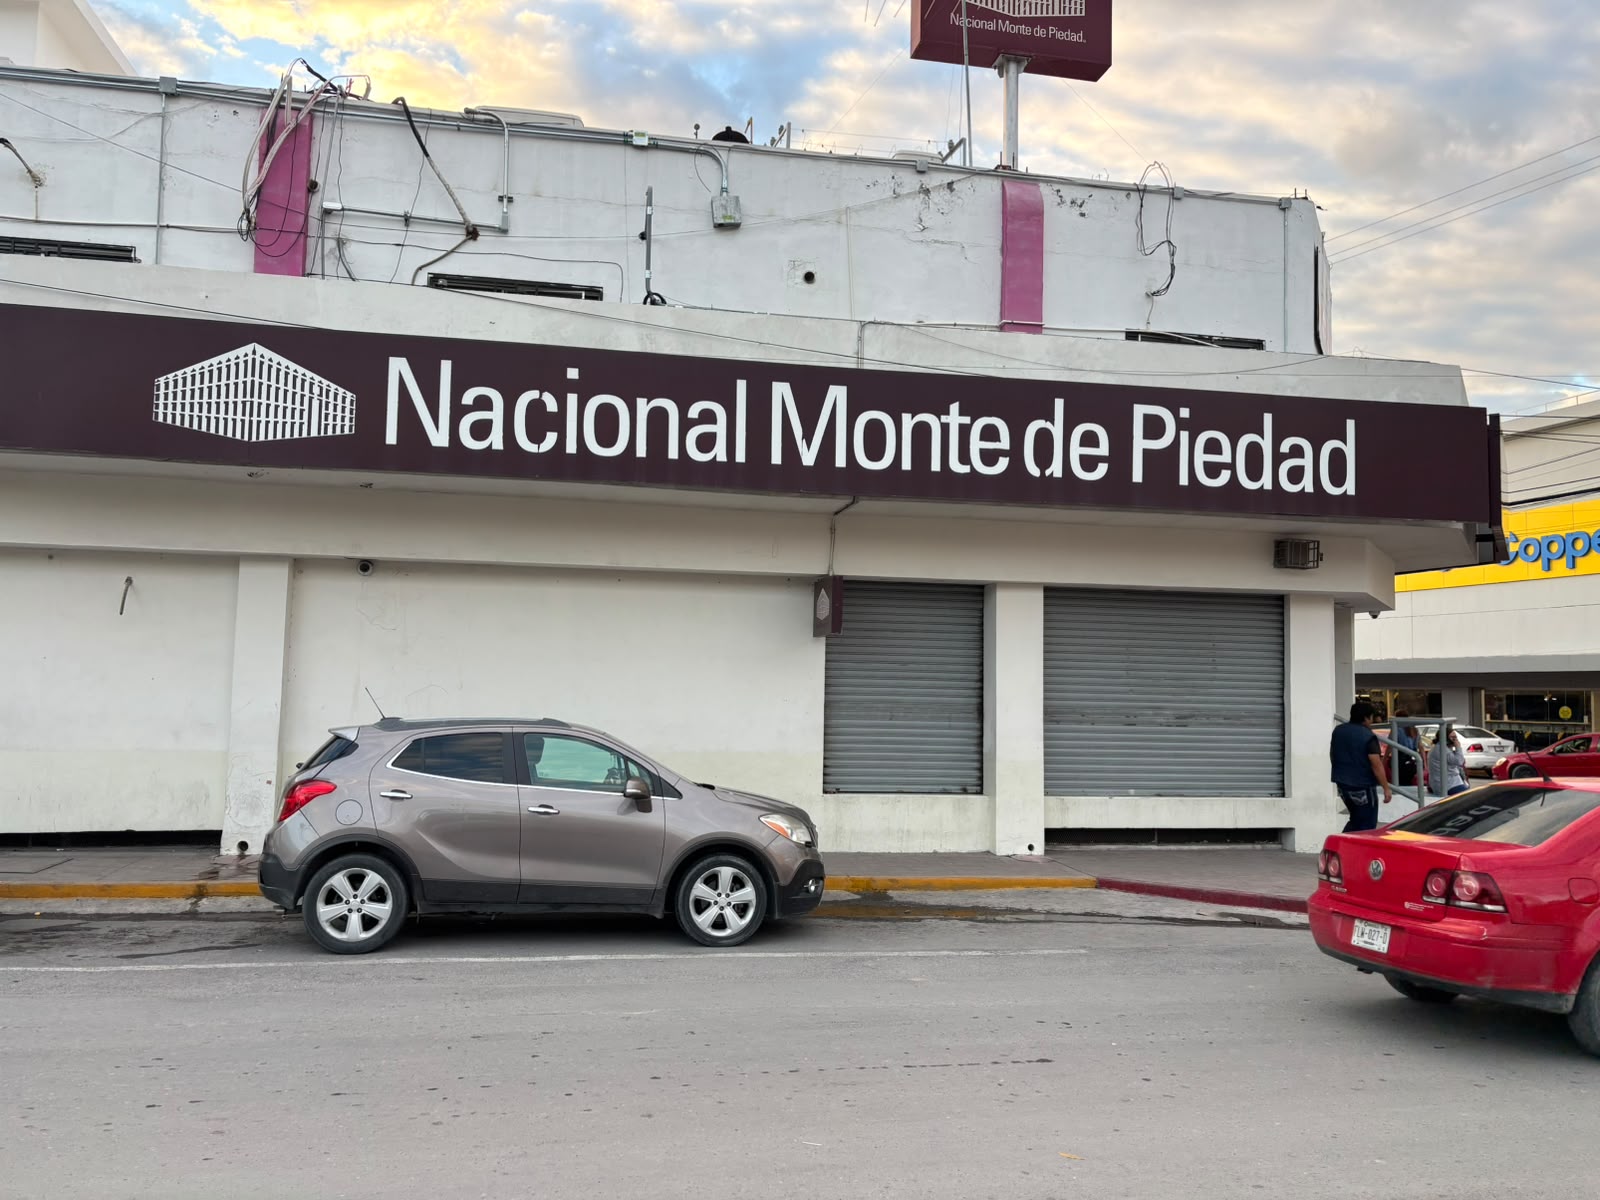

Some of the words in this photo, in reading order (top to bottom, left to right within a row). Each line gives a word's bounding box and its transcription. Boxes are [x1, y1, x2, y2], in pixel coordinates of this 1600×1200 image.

[950, 12, 996, 31] Nacional
[998, 19, 1032, 36] Monte
[1033, 24, 1047, 38] de
[385, 356, 747, 464] Nacional
[770, 381, 1010, 478] Monte
[1023, 397, 1110, 482] de
[1132, 403, 1356, 497] Piedad
